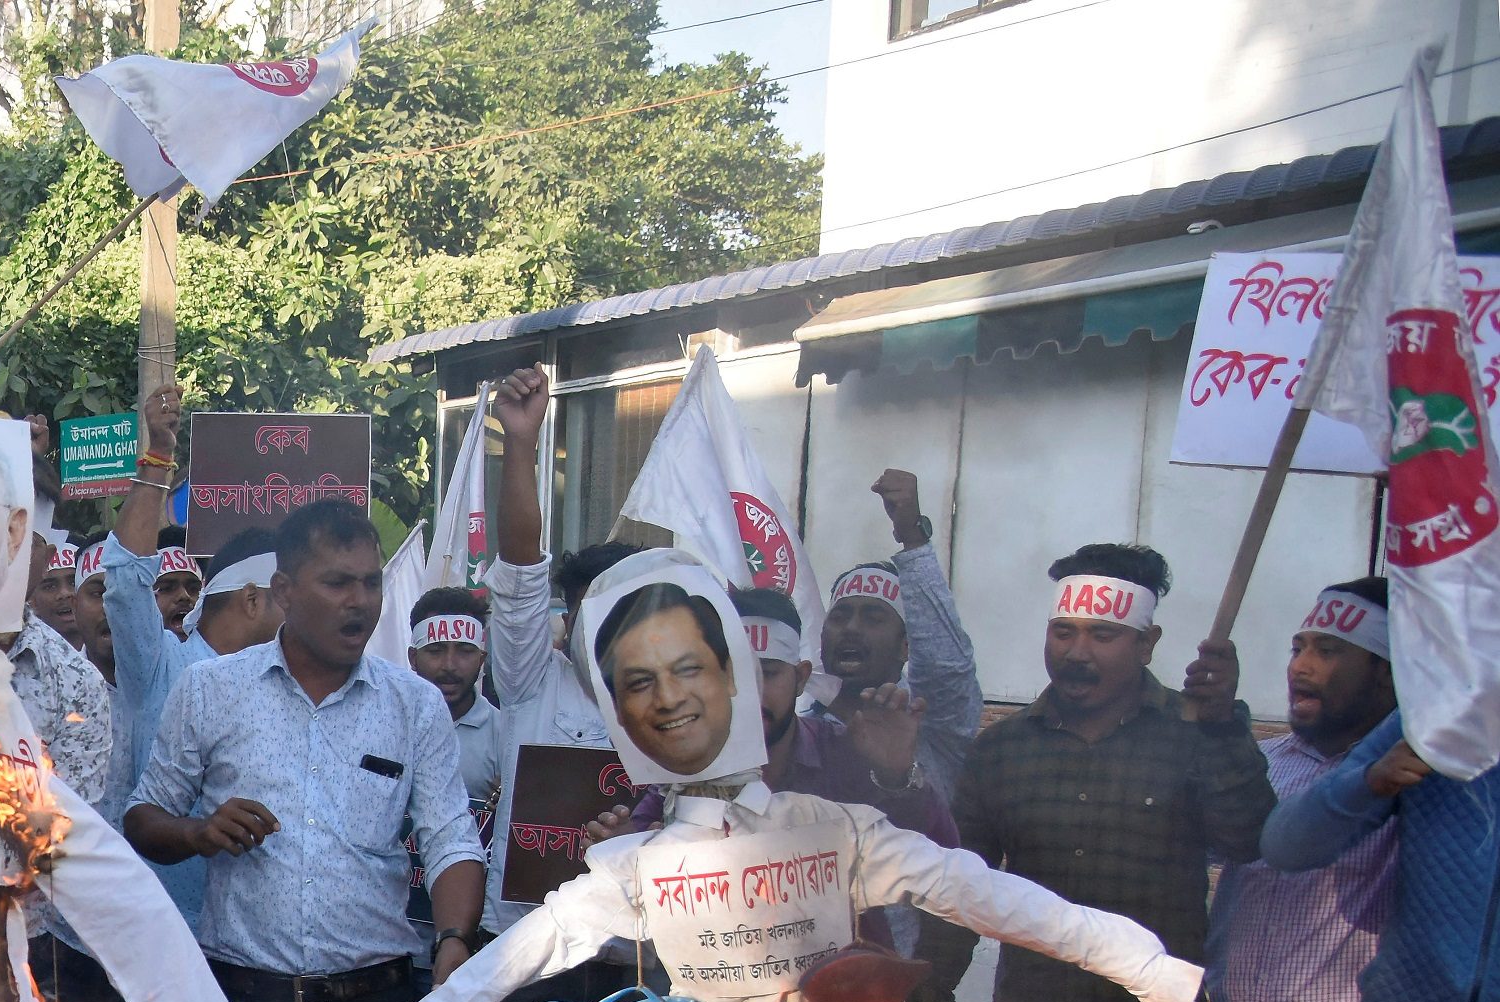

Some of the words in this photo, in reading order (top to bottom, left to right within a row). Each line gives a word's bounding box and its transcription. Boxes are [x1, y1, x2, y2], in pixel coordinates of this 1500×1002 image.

[70, 425, 110, 441] উমানন্দ
[255, 425, 311, 455] কেব
[63, 443, 113, 462] UMANANDA
[114, 440, 138, 457] GHAT
[1057, 584, 1134, 620] AASU
[427, 619, 476, 642] AASU
[698, 928, 719, 951] মই
[720, 923, 763, 948] জাতিয়
[678, 961, 698, 984] মই
[697, 960, 746, 983] অসমীয়া
[748, 955, 791, 979] জাতিৰ
